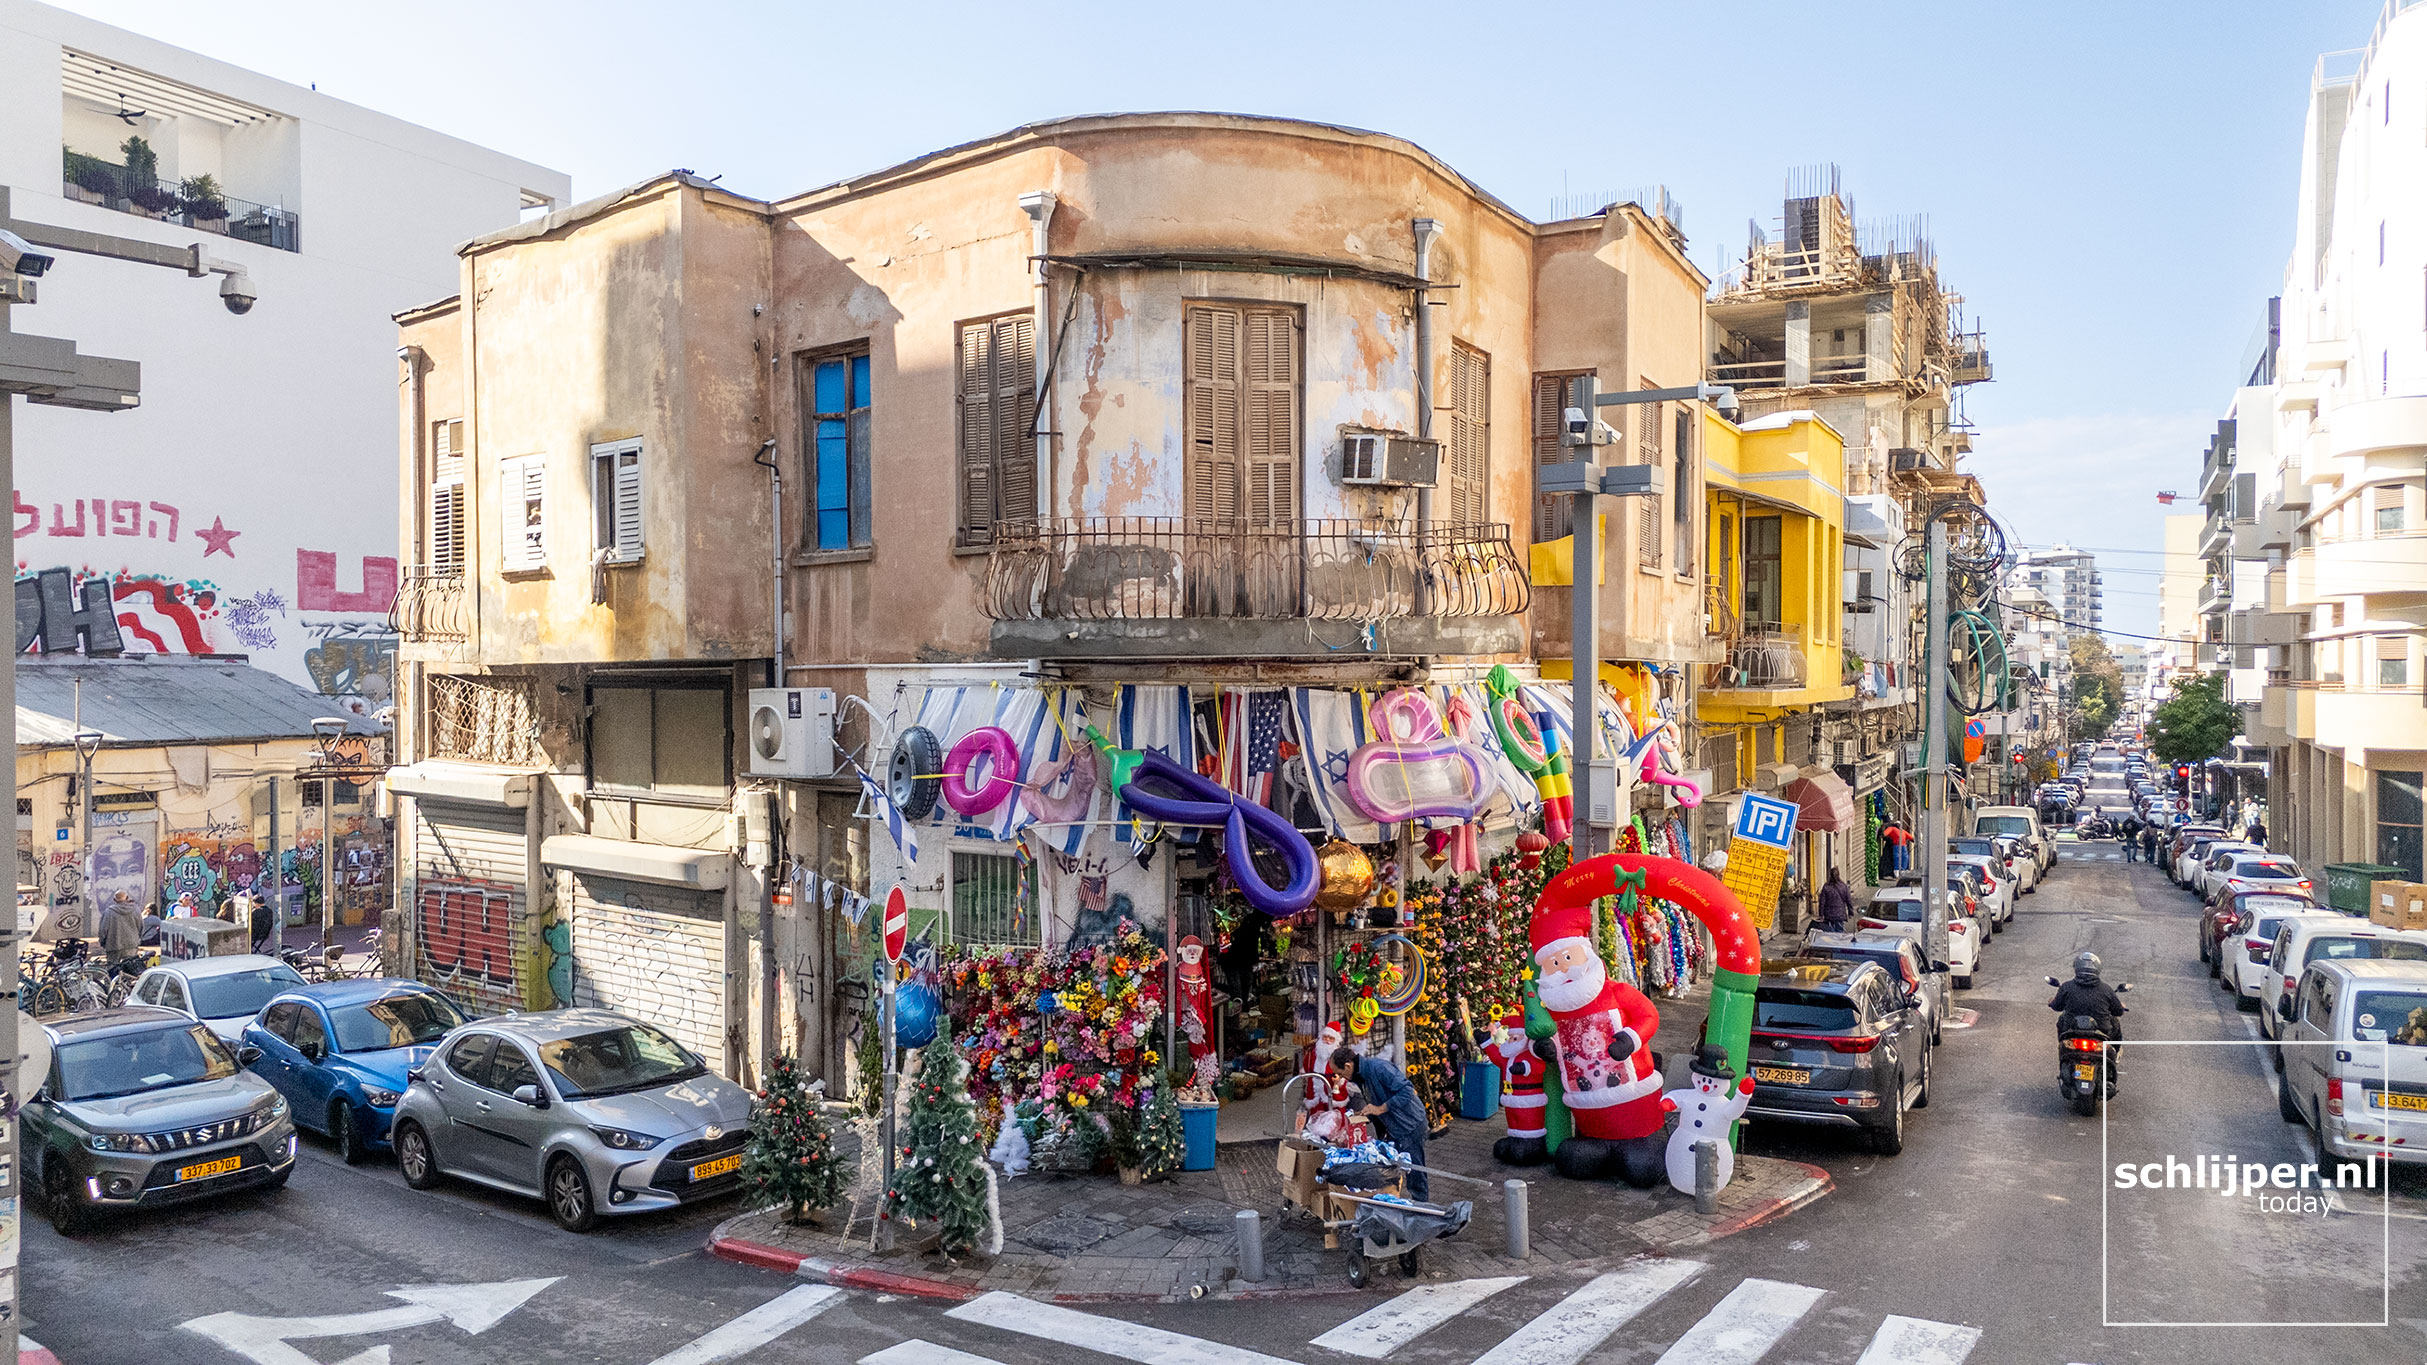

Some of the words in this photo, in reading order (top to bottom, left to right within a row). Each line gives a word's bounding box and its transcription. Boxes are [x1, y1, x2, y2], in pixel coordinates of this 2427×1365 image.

[13, 489, 180, 542] הפועל
[1563, 871, 1595, 889] Merry
[1667, 876, 1711, 908] Christmas
